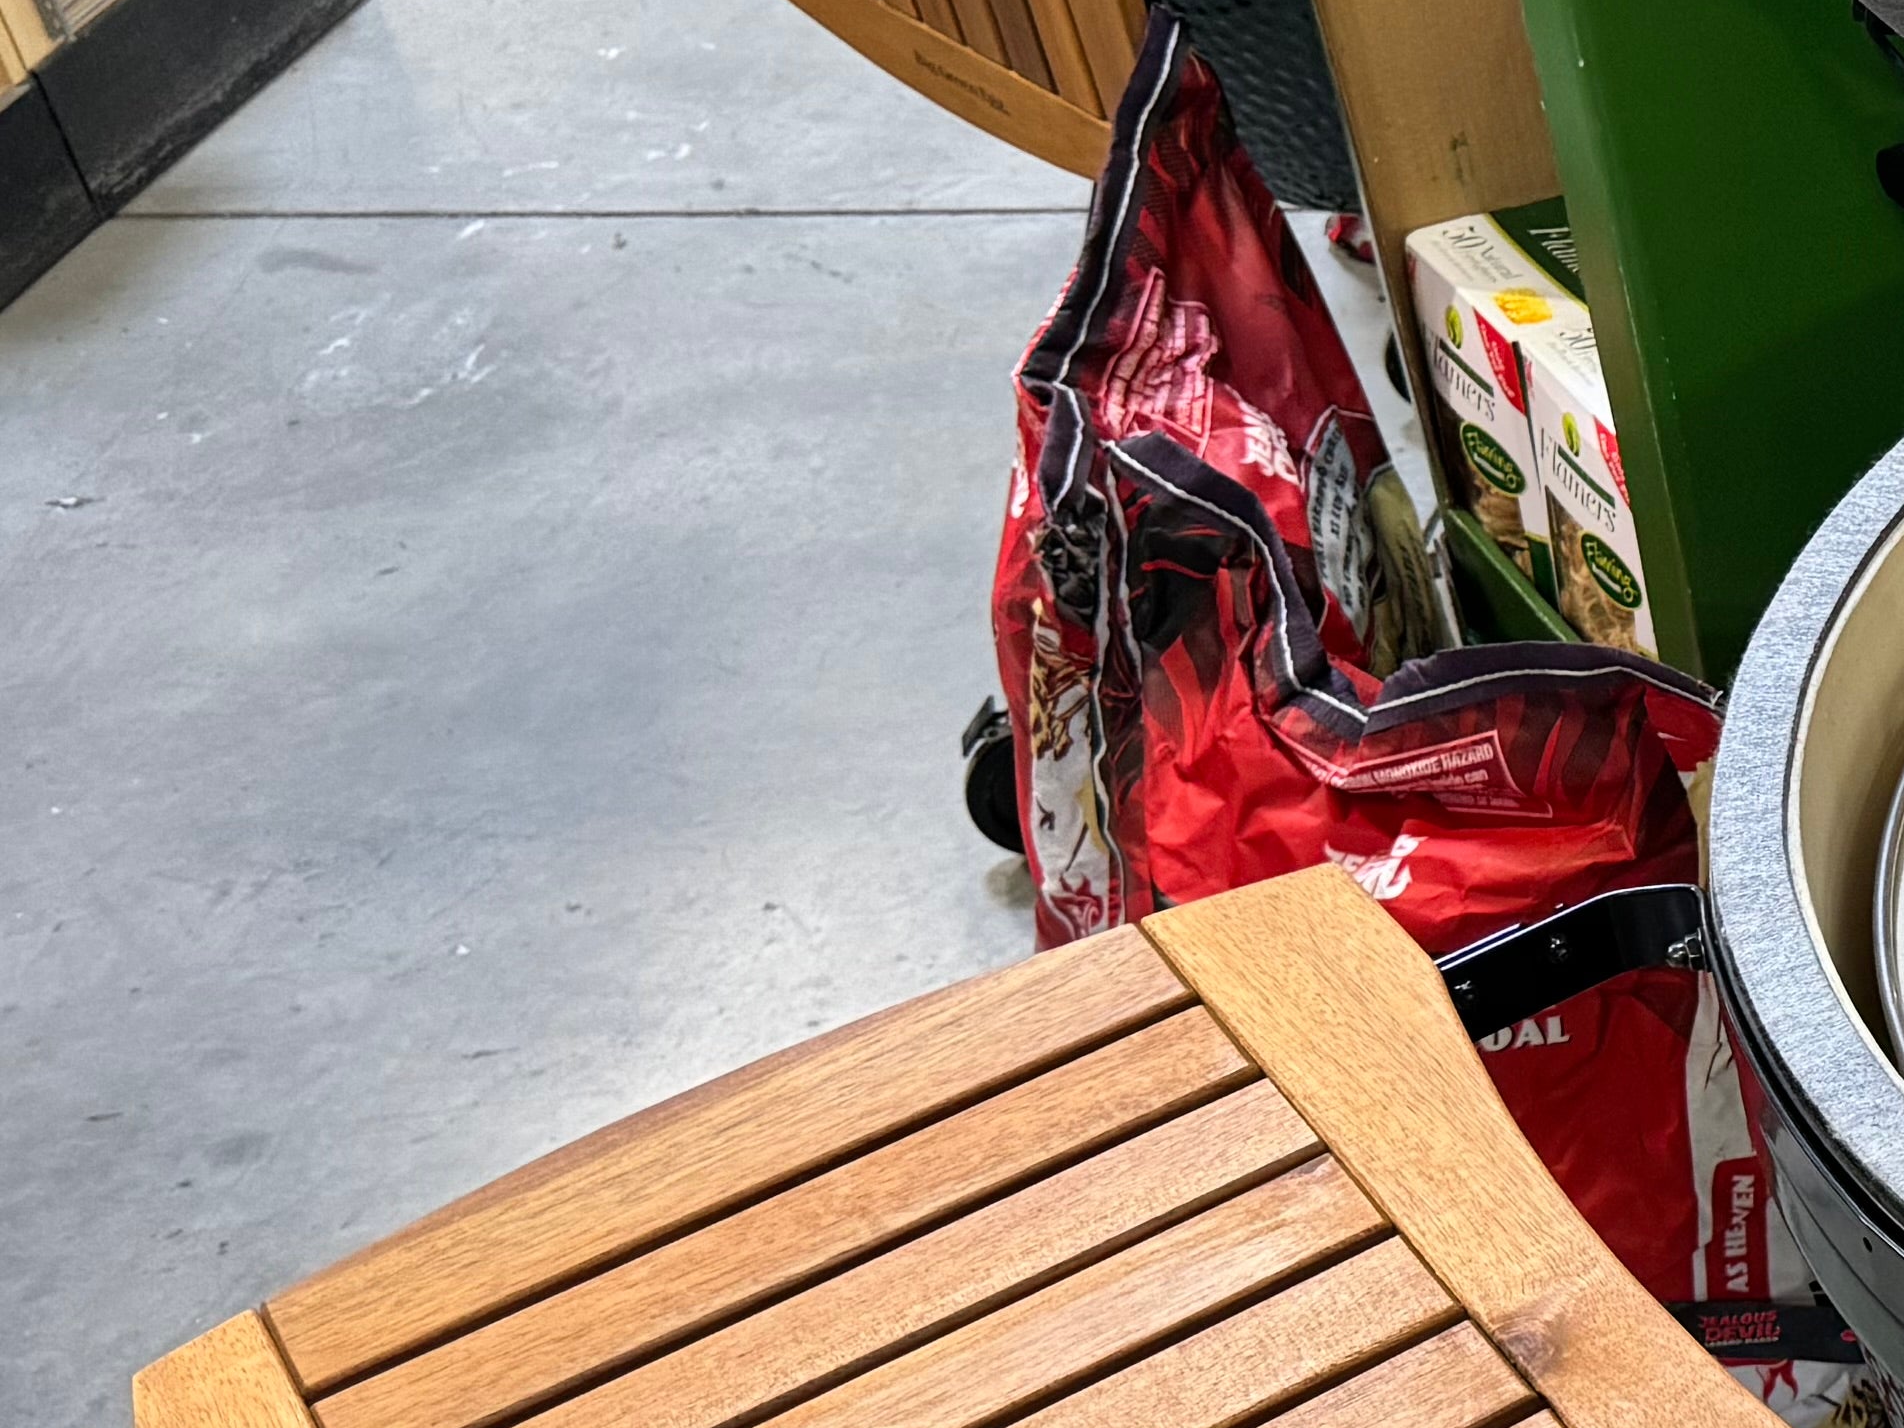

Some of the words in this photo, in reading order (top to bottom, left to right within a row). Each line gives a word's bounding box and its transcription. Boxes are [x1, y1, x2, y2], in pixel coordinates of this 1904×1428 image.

[1541, 427, 1616, 533] Flamers
[1441, 743, 1494, 772] HAZARD
[1726, 1261, 1749, 1293] AS
